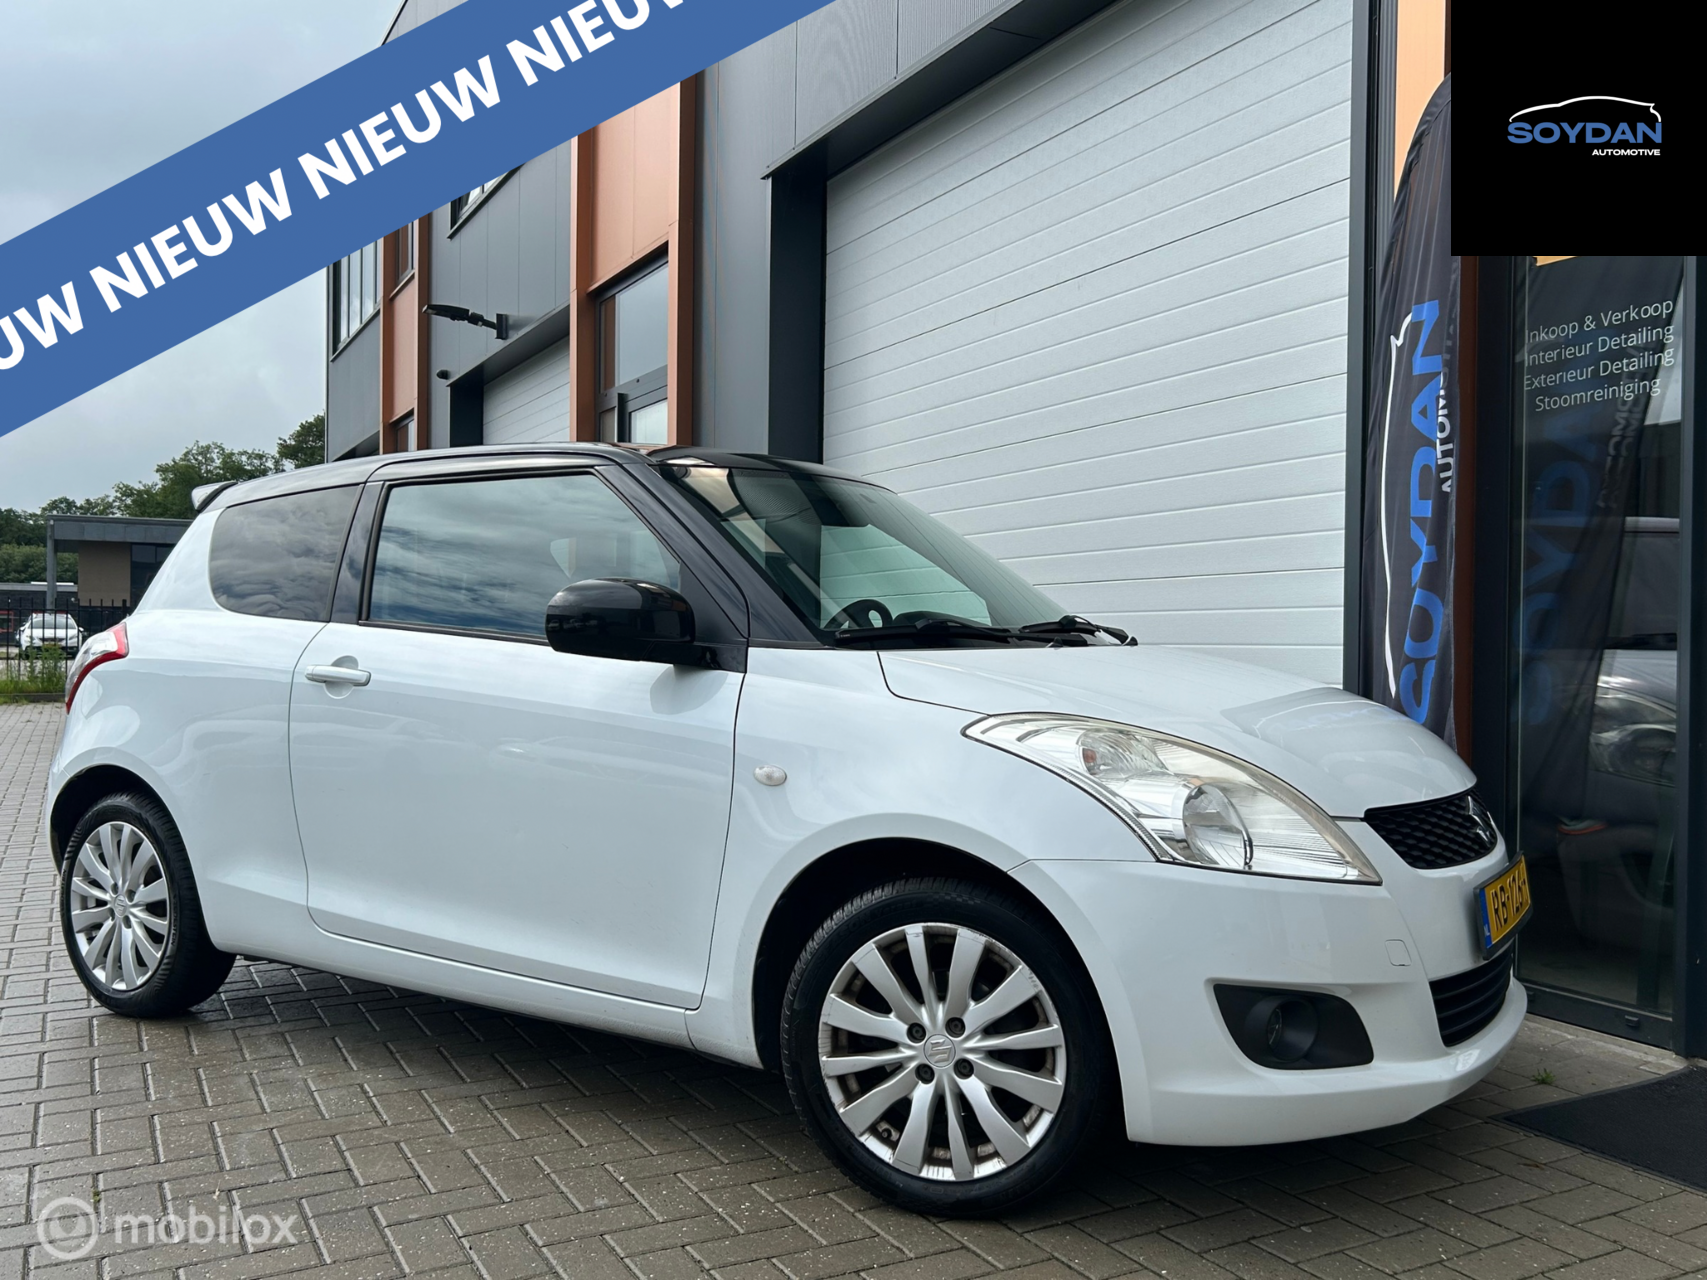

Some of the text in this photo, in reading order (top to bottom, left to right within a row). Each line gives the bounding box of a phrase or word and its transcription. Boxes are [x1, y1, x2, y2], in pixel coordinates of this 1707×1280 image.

[1525, 300, 1674, 344] Inkoop & Verkoop
[1525, 325, 1675, 367] Interieur Detailing
[1524, 348, 1675, 391] Exterieur Detailing
[1535, 378, 1662, 412] Stoomreiniging
[1400, 300, 1443, 724] SOYDAN
